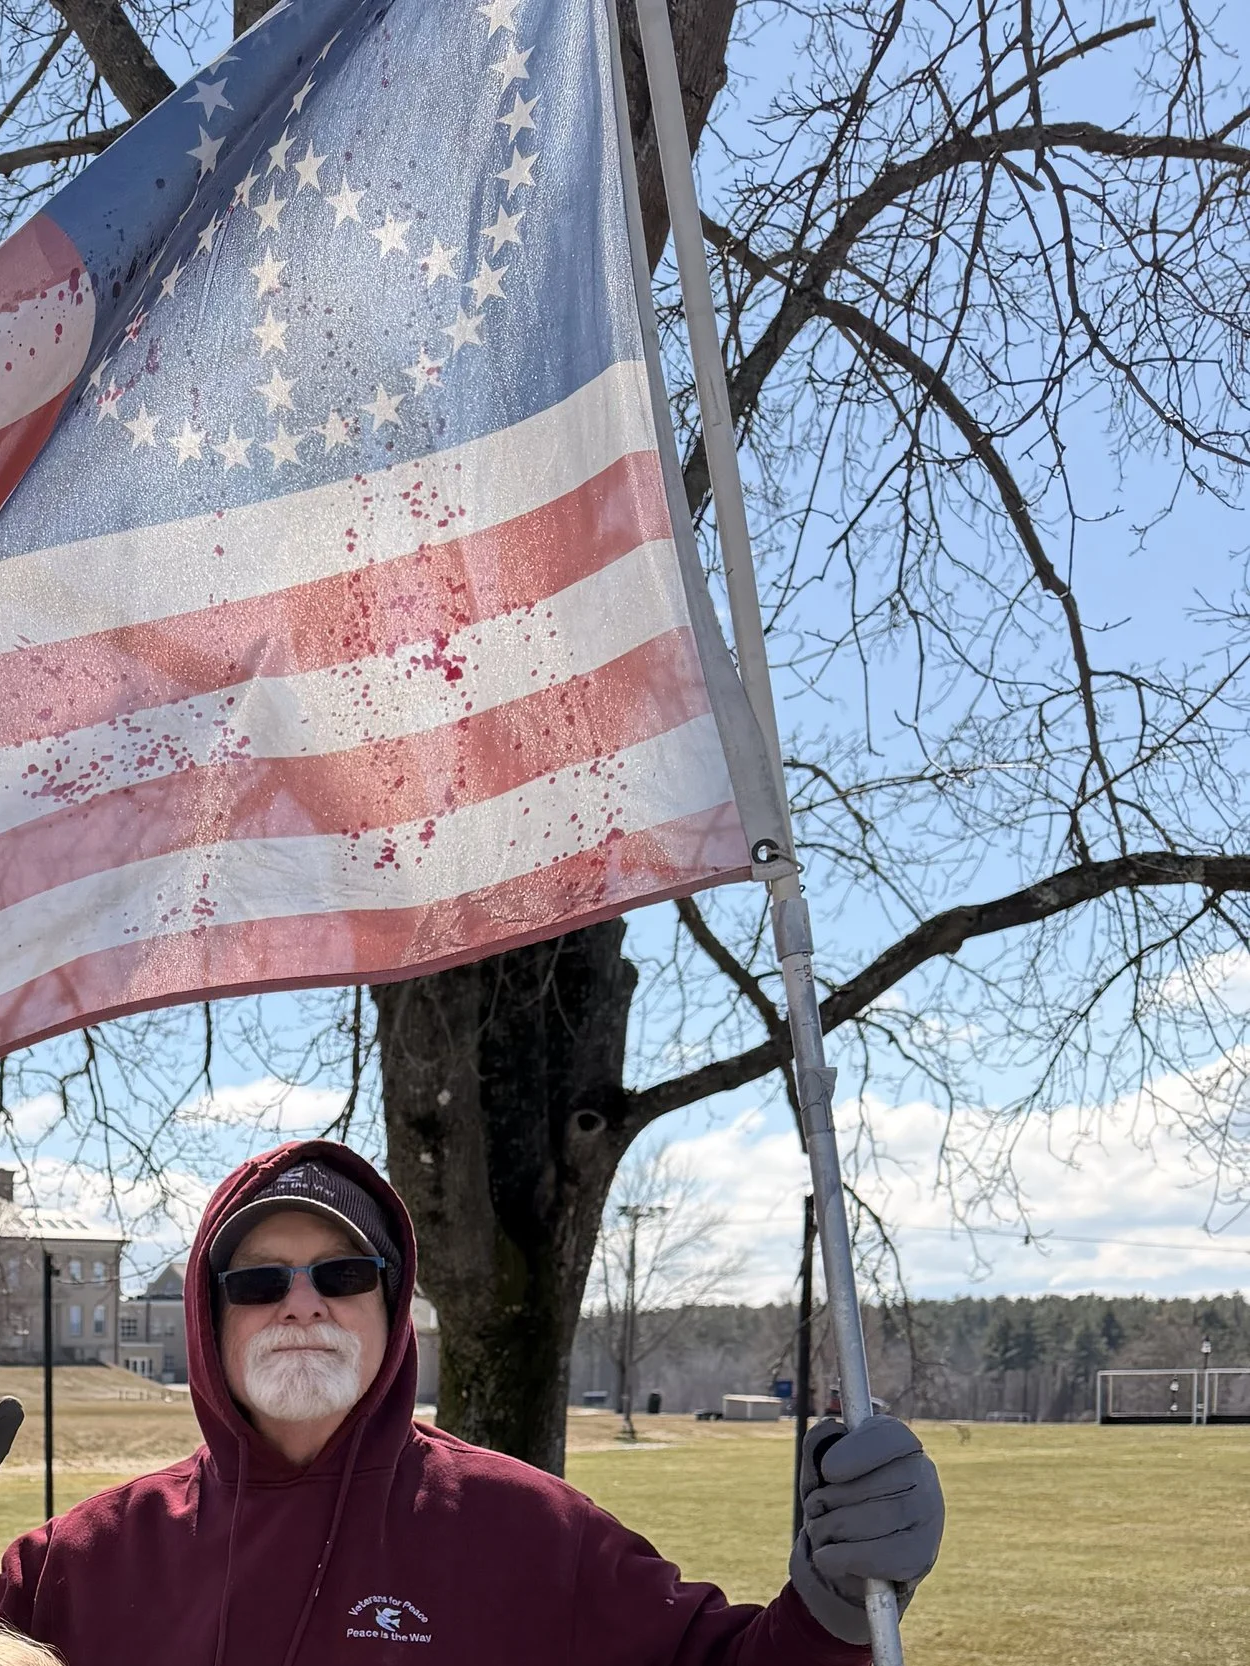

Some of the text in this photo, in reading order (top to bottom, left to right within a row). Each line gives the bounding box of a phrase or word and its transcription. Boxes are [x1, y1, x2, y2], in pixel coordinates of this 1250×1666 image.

[348, 1595, 429, 1623] Veterans for Peace
[346, 1628, 379, 1638] Peace
[391, 1632, 408, 1642] the
[409, 1633, 432, 1643] Way
